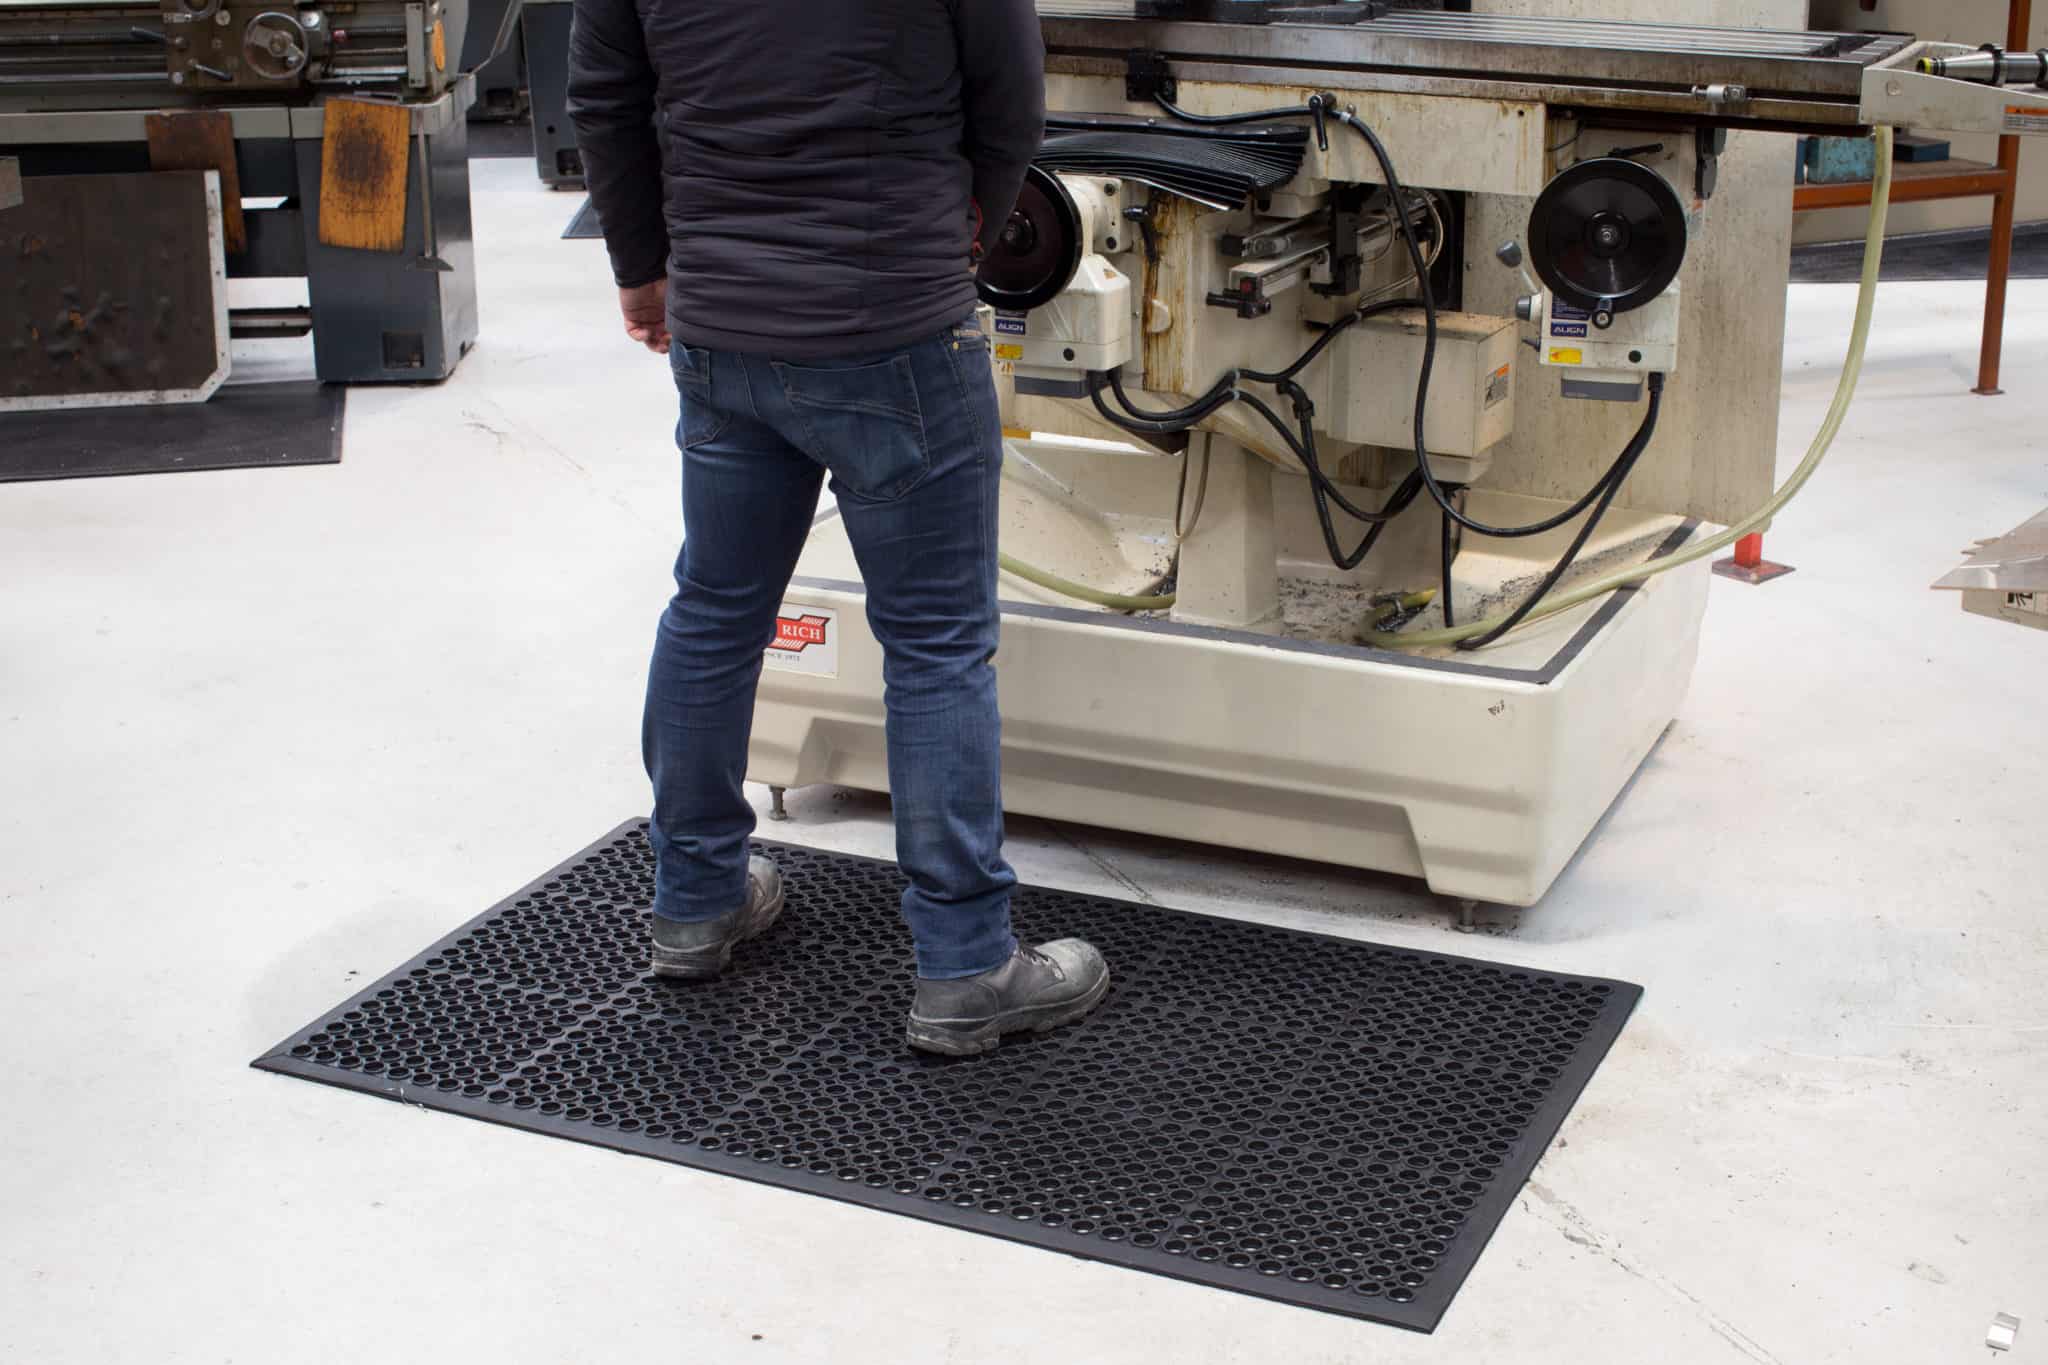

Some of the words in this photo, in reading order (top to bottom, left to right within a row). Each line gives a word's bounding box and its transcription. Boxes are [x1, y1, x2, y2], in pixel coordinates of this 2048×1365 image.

[998, 322, 1023, 332] ALIGN
[1553, 326, 1584, 334] ALIGN
[782, 624, 820, 640] RICH
